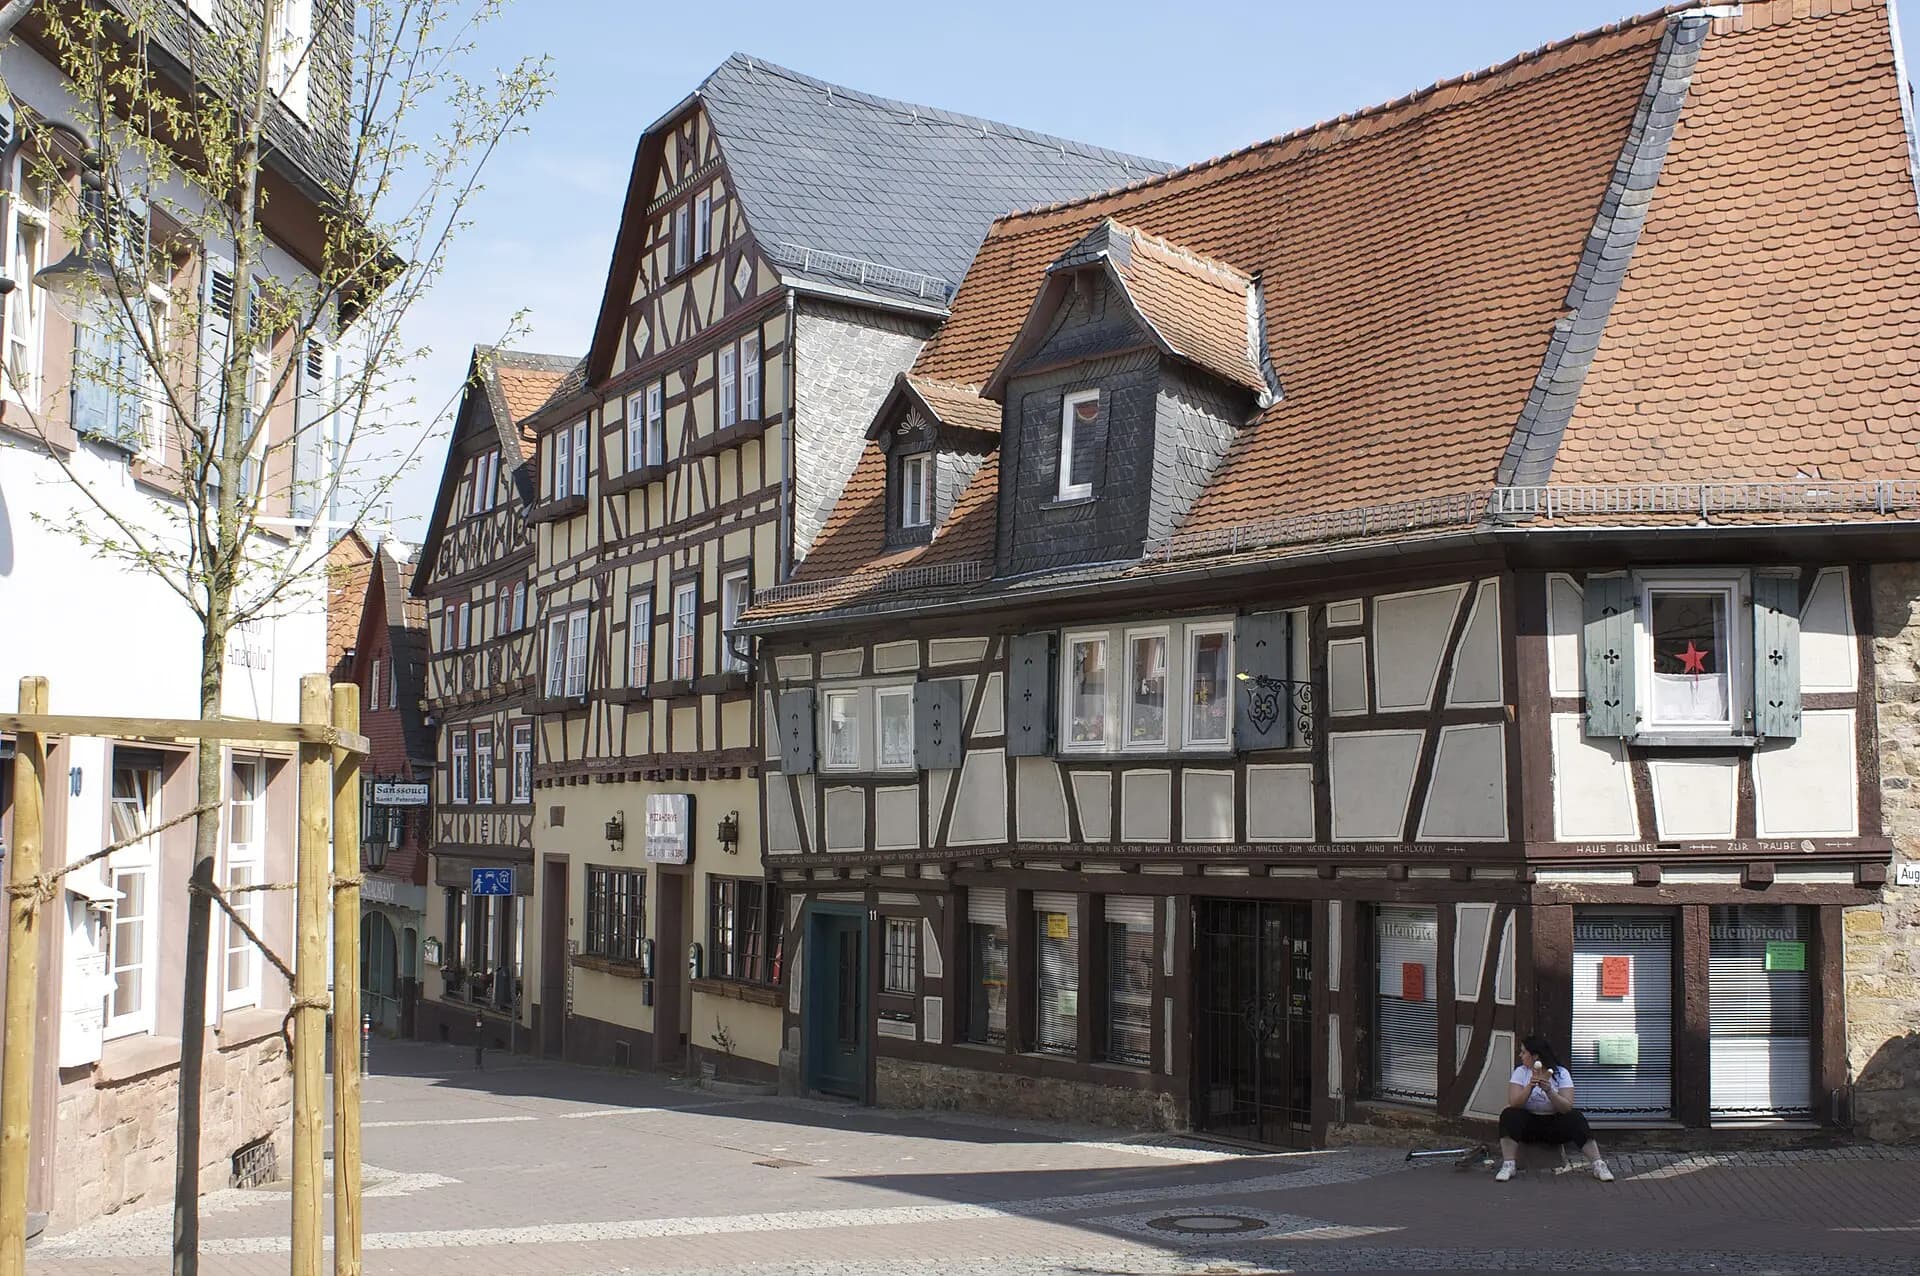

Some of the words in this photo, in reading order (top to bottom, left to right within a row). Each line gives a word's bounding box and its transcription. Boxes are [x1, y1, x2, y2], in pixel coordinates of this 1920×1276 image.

[69, 766, 82, 797] 10
[376, 785, 427, 795] Sanssouci
[1308, 845, 1356, 853] WEITERGEBEN
[1365, 845, 1385, 853] ANNO
[1576, 843, 1607, 853] HAUS
[1727, 842, 1749, 851] ZUR
[1758, 841, 1796, 851] TRAUBE
[869, 910, 877, 920] 11
